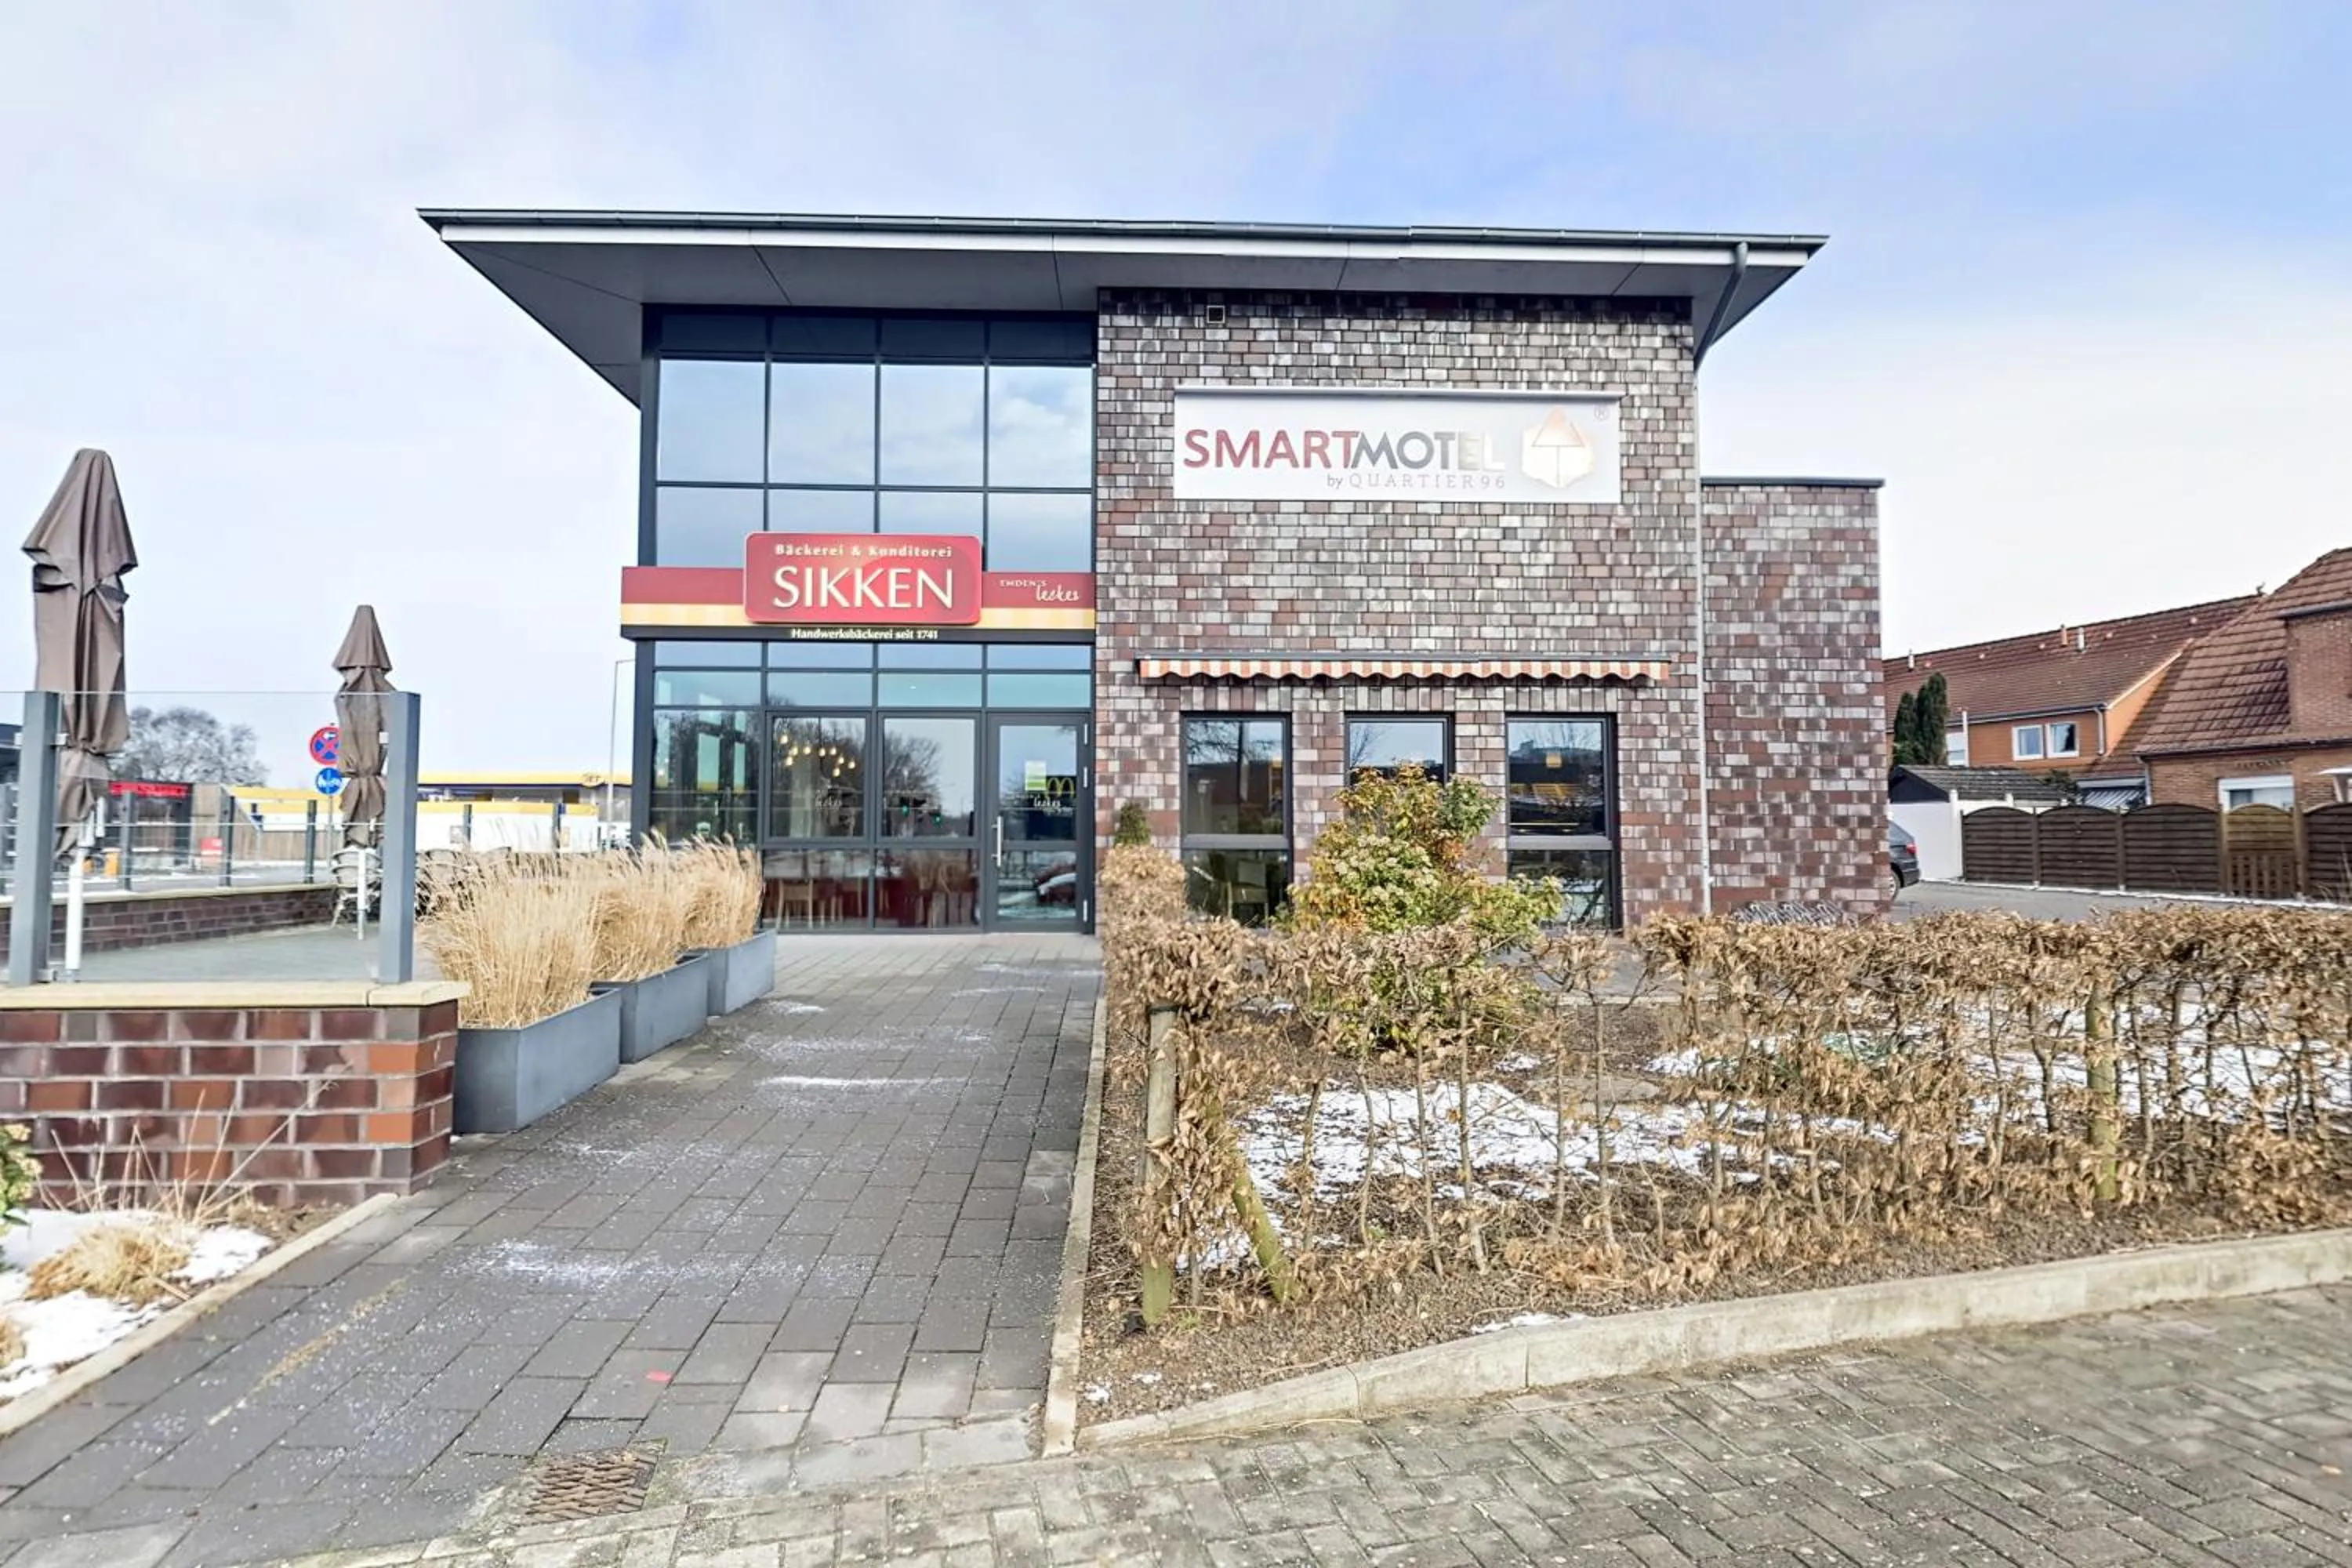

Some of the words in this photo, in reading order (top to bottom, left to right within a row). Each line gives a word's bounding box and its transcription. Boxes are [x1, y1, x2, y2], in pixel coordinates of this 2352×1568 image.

[1182, 428, 1506, 471] SMARTMOTEL
[1327, 474, 1343, 490] by
[775, 543, 844, 557] Bäckerei
[851, 544, 862, 557] &
[868, 545, 952, 557] Konditorei
[773, 565, 953, 609] SIKKEN
[790, 627, 894, 640] Handwerksbäckerei
[895, 628, 914, 640] seit
[916, 629, 938, 640] 1741
